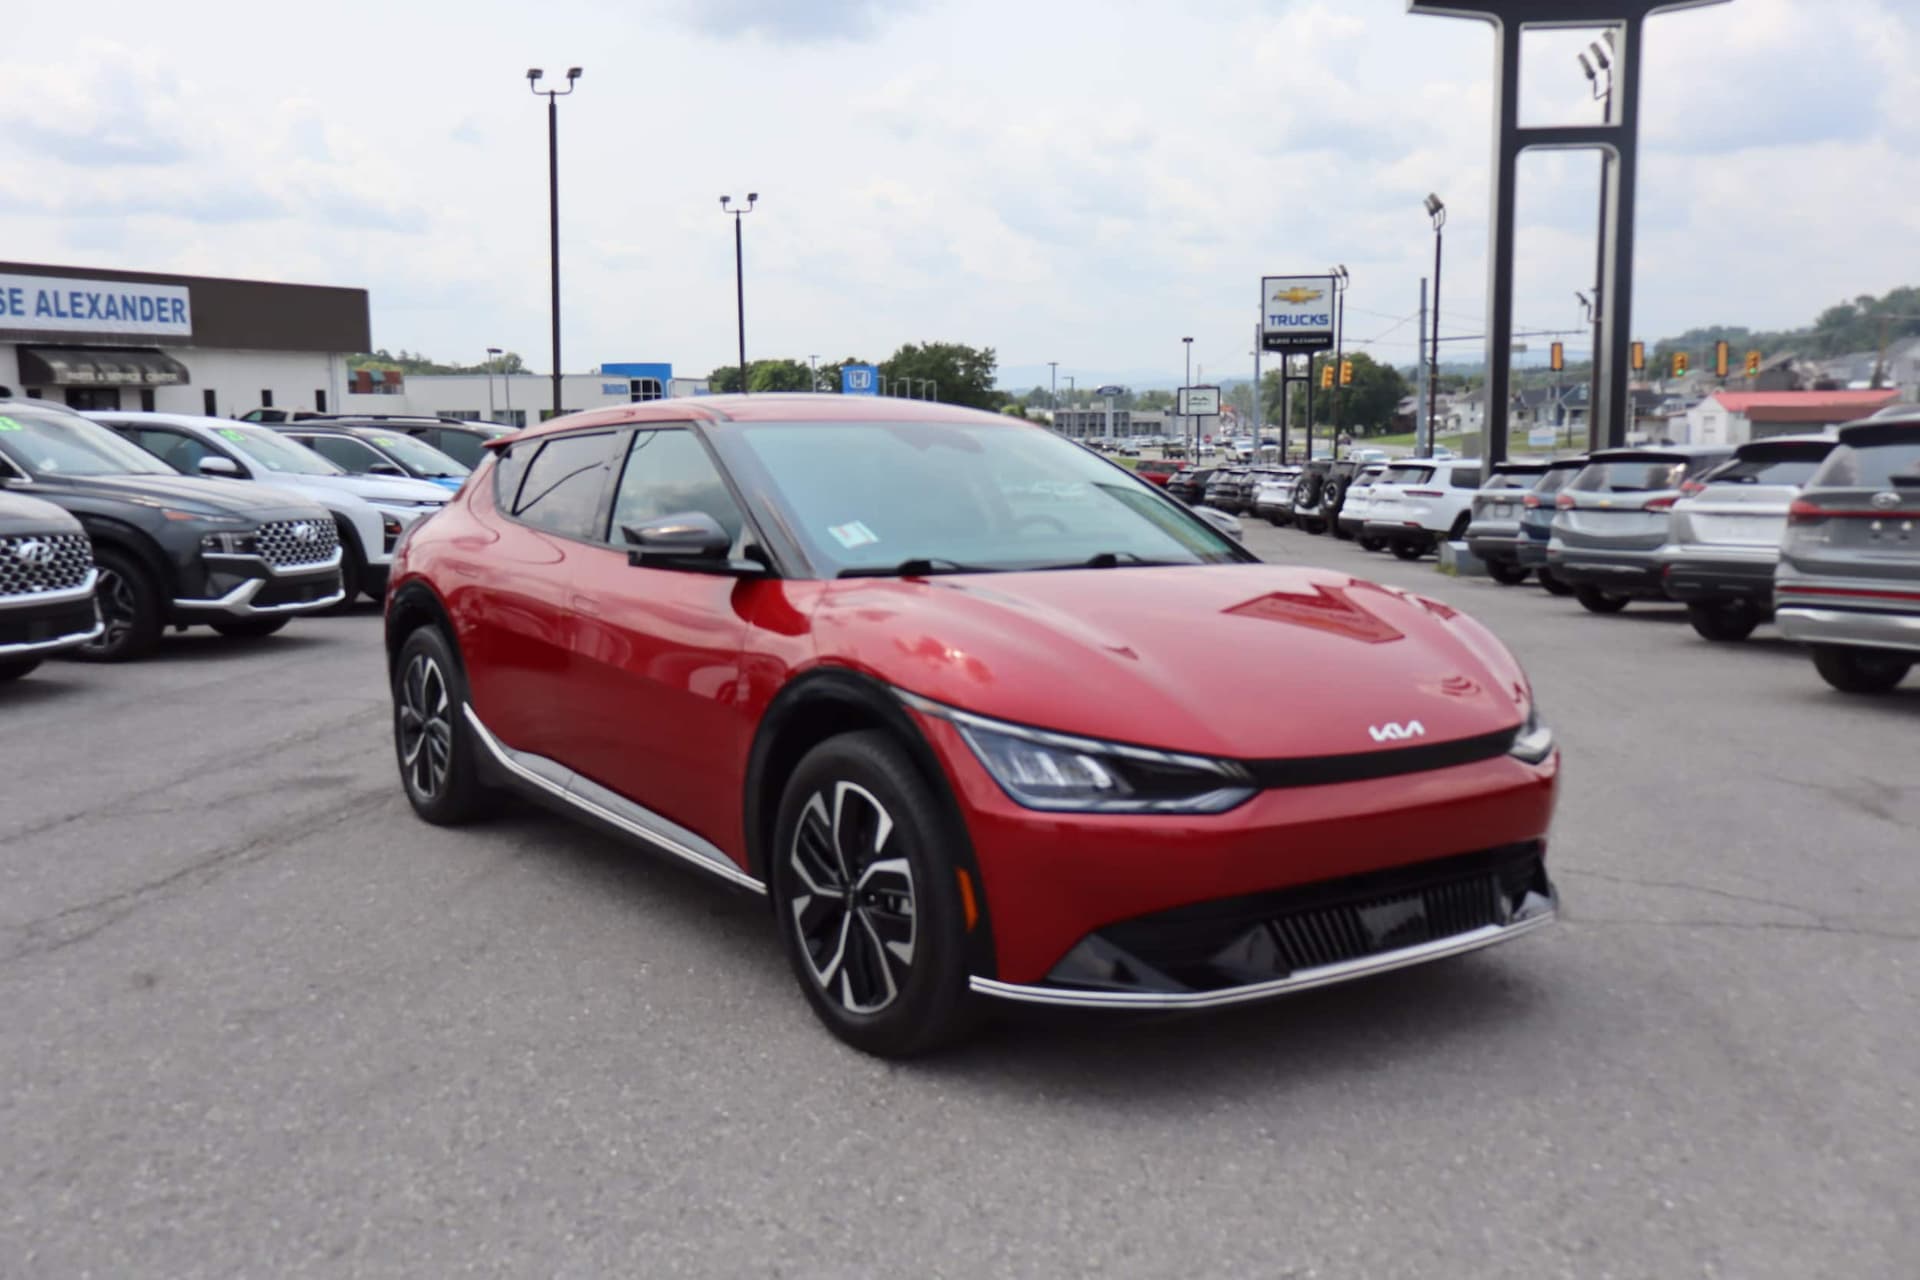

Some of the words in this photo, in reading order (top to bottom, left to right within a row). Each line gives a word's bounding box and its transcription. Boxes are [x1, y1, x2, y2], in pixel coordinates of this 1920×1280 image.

[35, 289, 187, 324] ALEXANDER
[1268, 313, 1329, 326] TRUCKS
[1368, 719, 1425, 742] KIA
